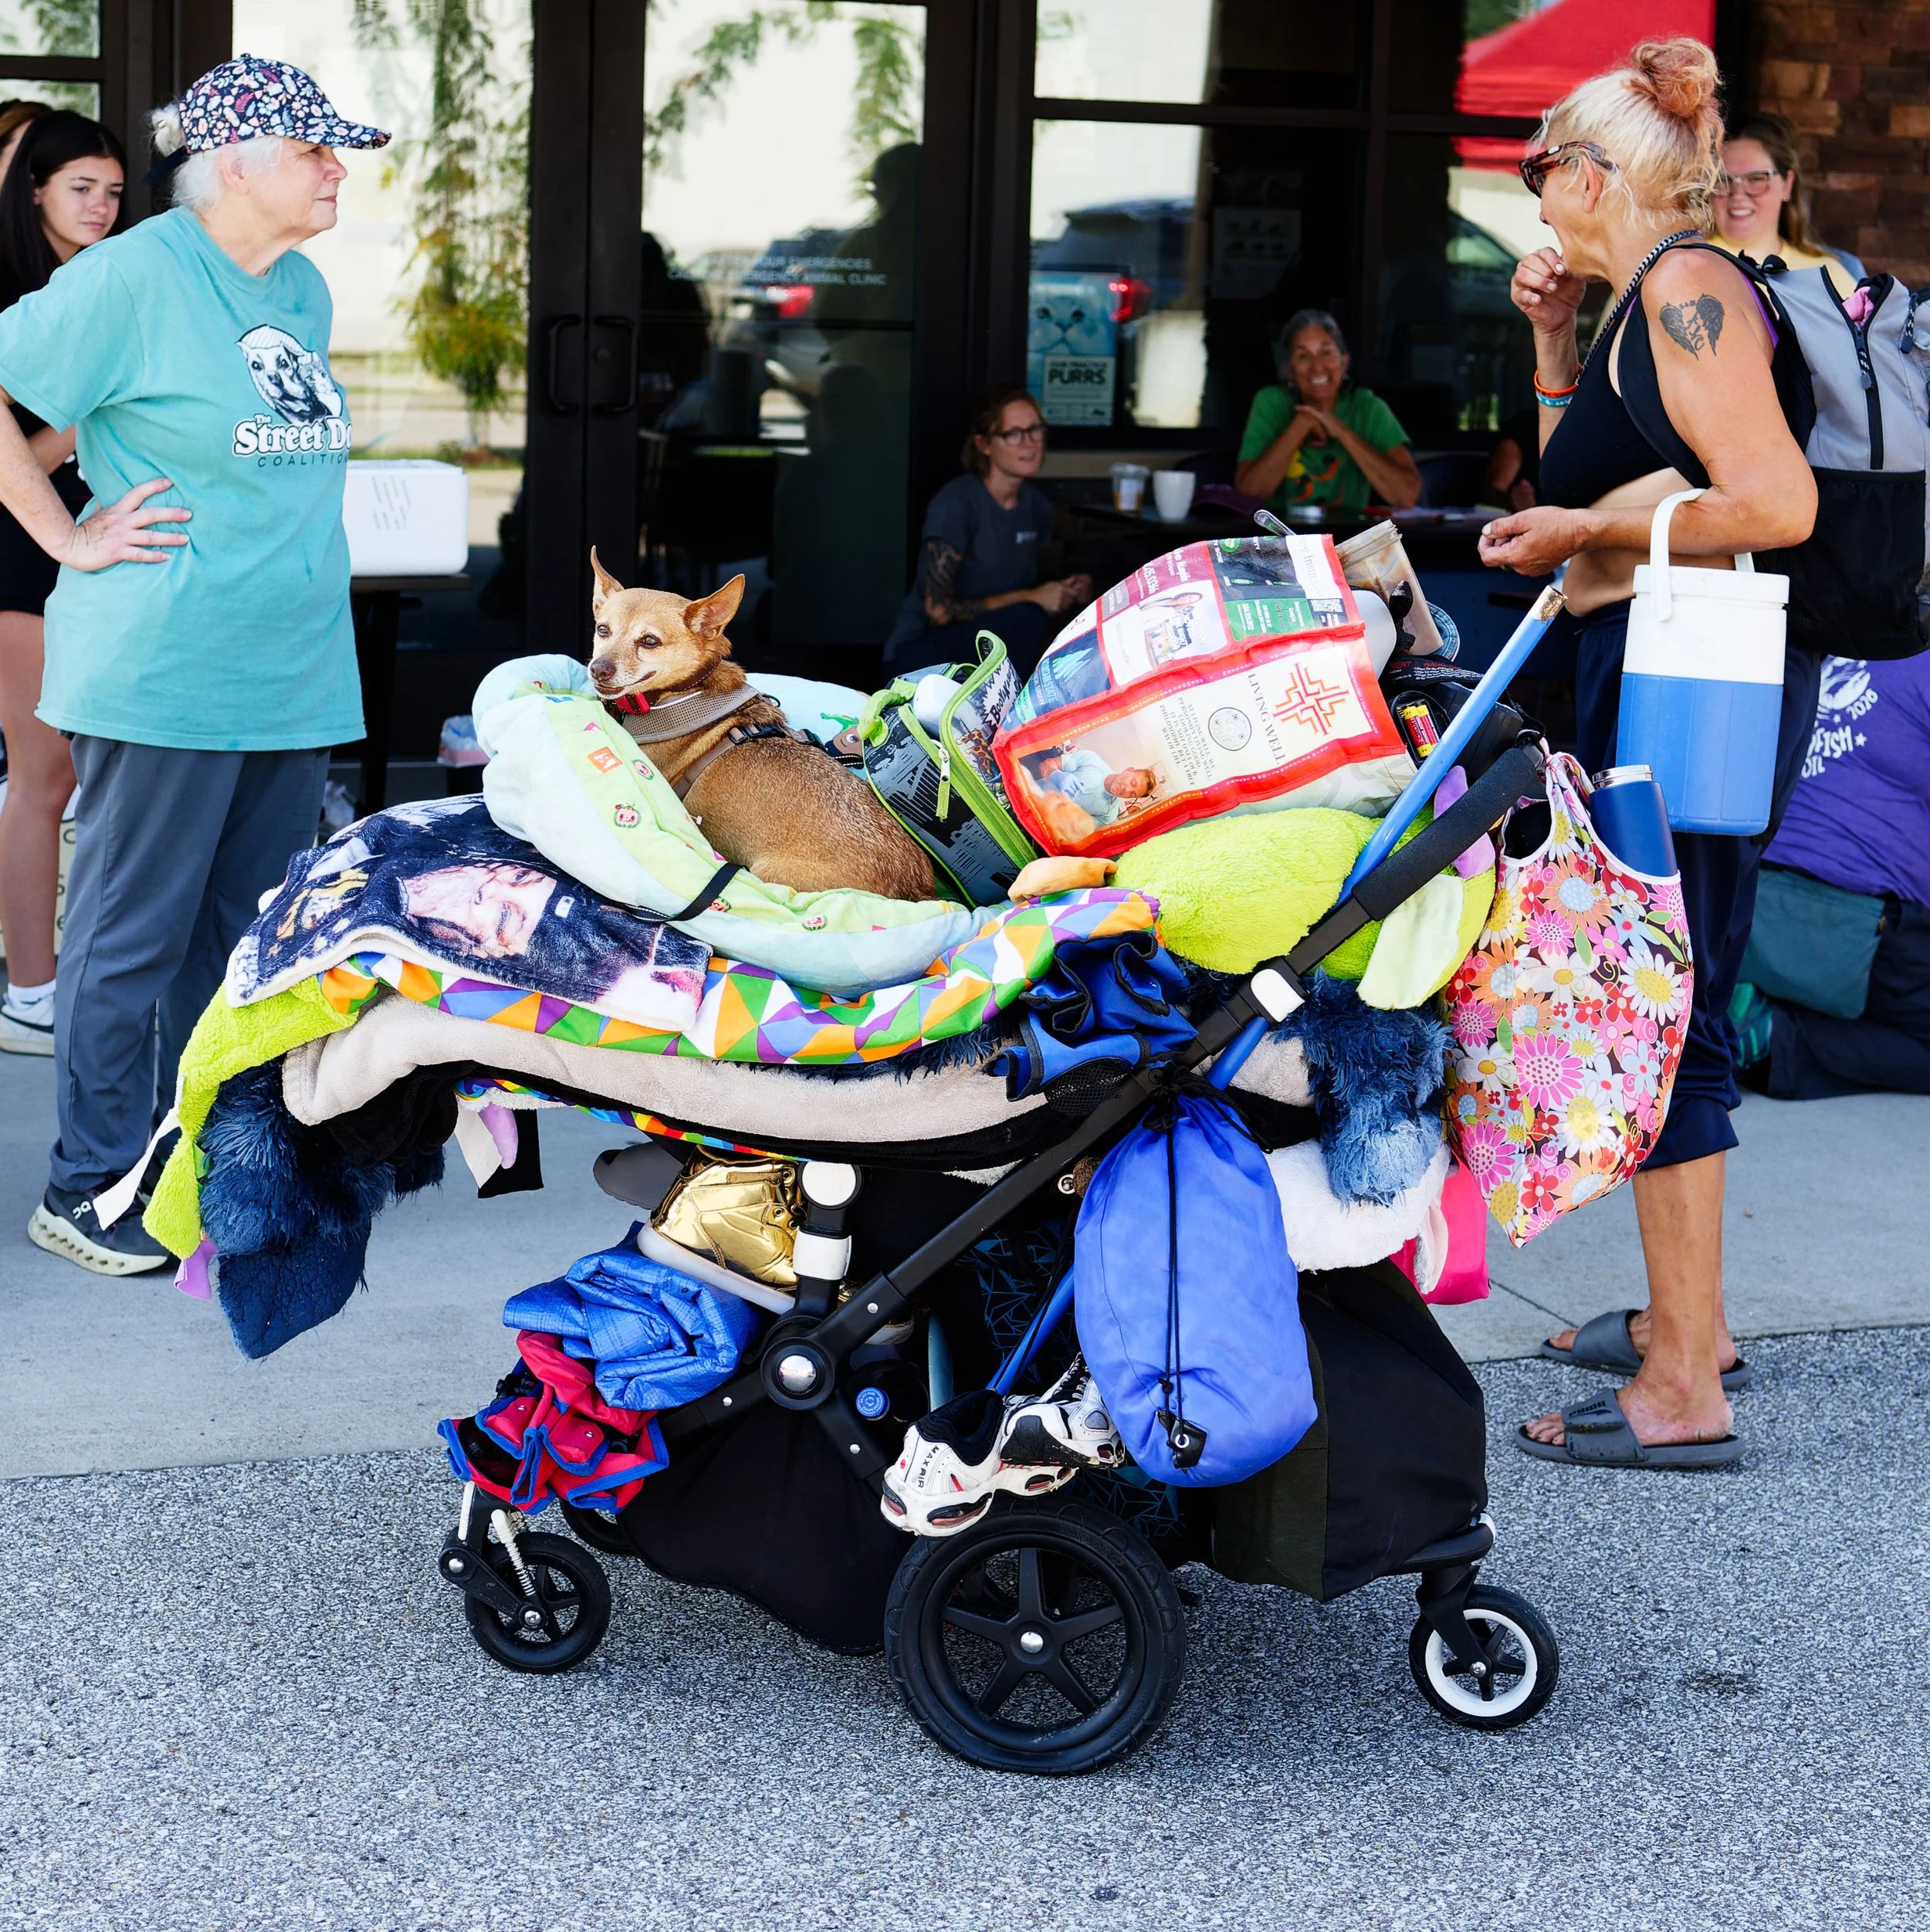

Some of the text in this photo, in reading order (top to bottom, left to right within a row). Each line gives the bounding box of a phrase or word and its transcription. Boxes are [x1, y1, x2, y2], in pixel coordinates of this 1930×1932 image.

[790, 256, 872, 270] EMERGENCIES
[848, 273, 887, 285] CLINIC
[1048, 367, 1107, 385] PURRS
[234, 419, 324, 455] Street
[1043, 681, 1058, 703] STATE
[1248, 673, 1285, 765] LIVING WELL
[1807, 725, 1854, 759] FISH
[918, 1446, 940, 1488] MAX AIR
